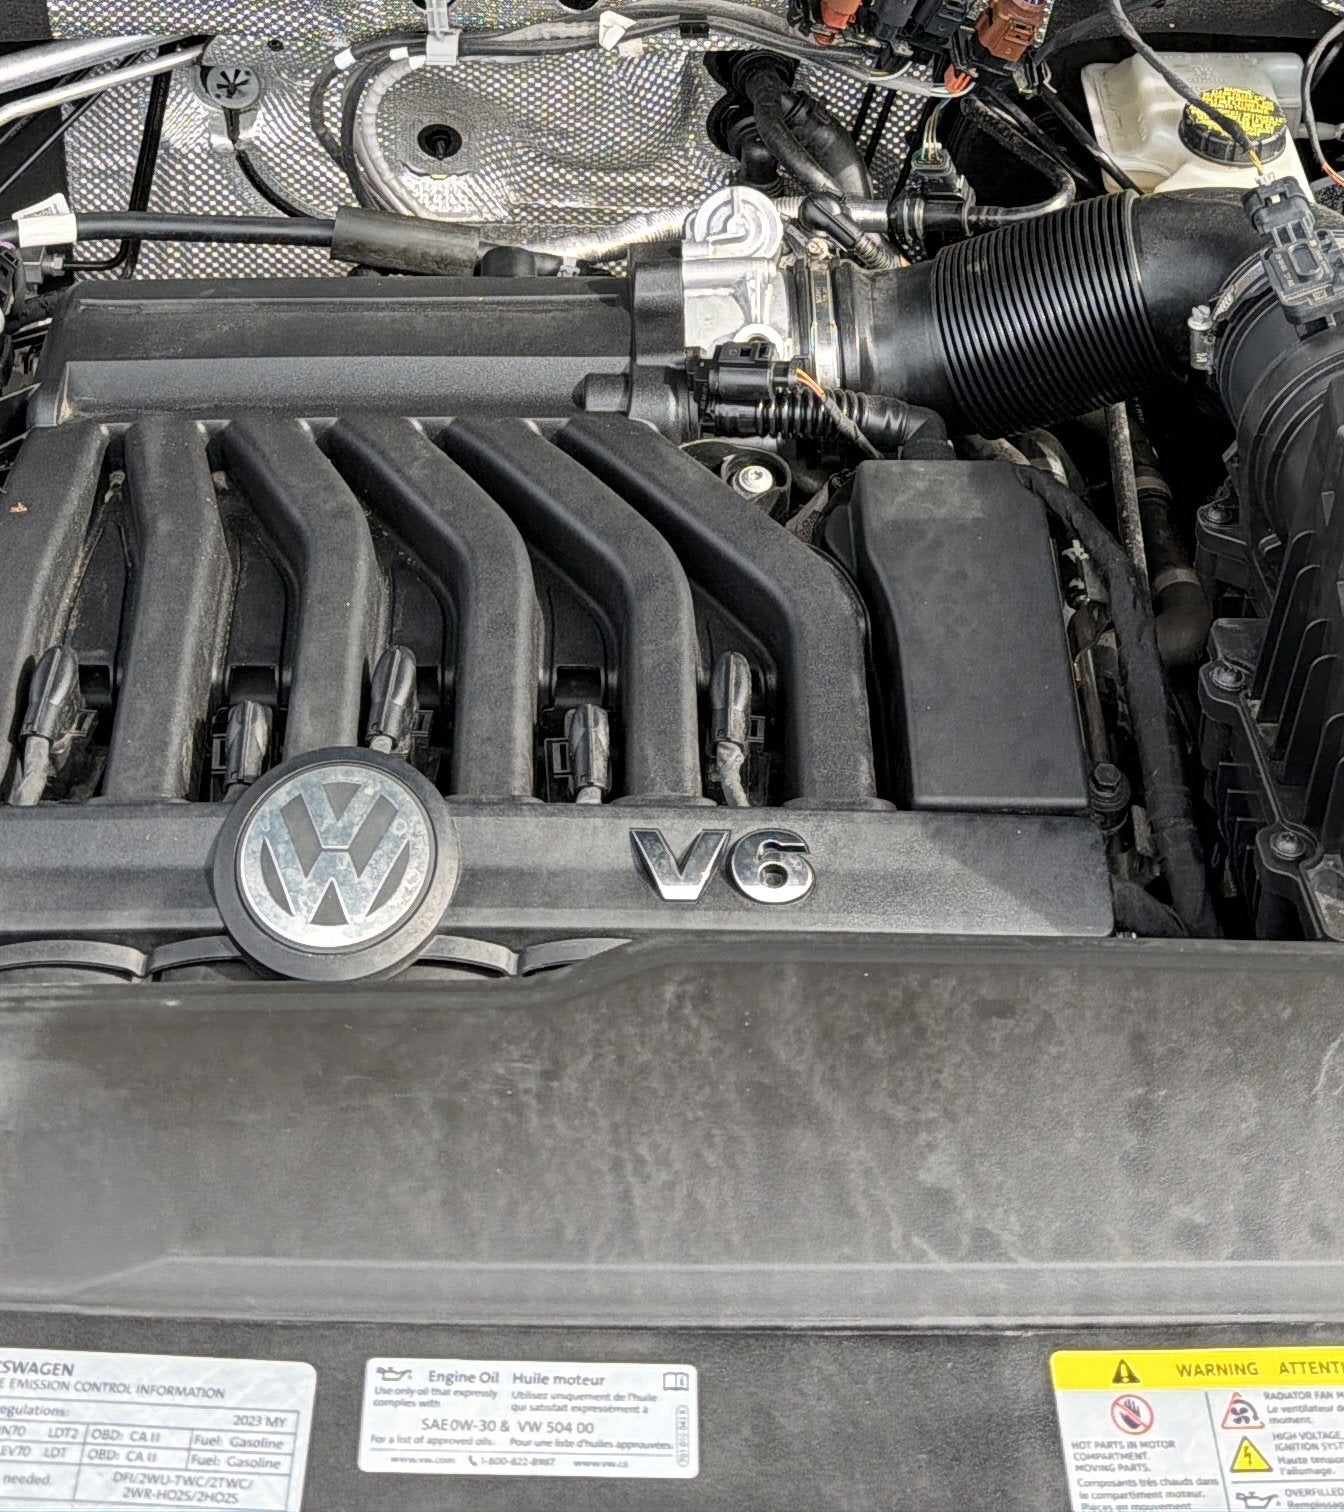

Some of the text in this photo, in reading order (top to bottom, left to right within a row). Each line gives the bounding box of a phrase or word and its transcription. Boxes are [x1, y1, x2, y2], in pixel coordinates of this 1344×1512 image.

[629, 827, 816, 904] V6
[1176, 1362, 1259, 1377] WARNING
[428, 1370, 500, 1386] Engine Oil
[512, 1372, 606, 1387] Huile moteur
[9, 1377, 71, 1391] EMISSION
[74, 1380, 132, 1394] CONTROL
[136, 1384, 226, 1399] INFORMATION
[374, 1386, 498, 1400] Use only oil that expressly
[613, 1393, 626, 1402] de
[1263, 1391, 1312, 1400] RADIATOR
[1314, 1391, 1333, 1399] FAN
[418, 1399, 441, 1408] with
[1267, 1405, 1278, 1413] Le
[1281, 1404, 1334, 1413] ventilateur
[233, 1415, 262, 1427] 2023
[265, 1416, 287, 1428] MY
[421, 1418, 595, 1434] SAE 0W-30 & VW 504 00
[48, 1427, 79, 1439] LDT2
[91, 1429, 124, 1441] OBD:
[129, 1431, 148, 1443] CA
[193, 1434, 224, 1446] Fuel:
[229, 1437, 285, 1450] Gasoline
[370, 1434, 387, 1444] For
[396, 1435, 411, 1444] list
[1273, 1432, 1297, 1441] HIGH
[509, 1438, 532, 1447] Pour
[554, 1439, 575, 1448] liste
[1071, 1440, 1091, 1449] HOT
[1094, 1440, 1125, 1449] PARTS
[1139, 1440, 1176, 1448] MOTOR
[1275, 1442, 1319, 1452] IGNITION
[43, 1446, 68, 1458] LDT
[87, 1449, 120, 1461] OBD:
[125, 1451, 145, 1463] CA
[190, 1454, 221, 1467] Fuel:
[226, 1456, 282, 1470] Gasoline
[1277, 1455, 1308, 1464] Haute
[1075, 1463, 1116, 1472] MOVING
[3, 1472, 52, 1486] needed.
[1077, 1478, 1138, 1489] Composants
[1159, 1477, 1194, 1486] chauds
[1091, 1490, 1163, 1501] compartiment
[1285, 1488, 1344, 1497] OVERFILLED
